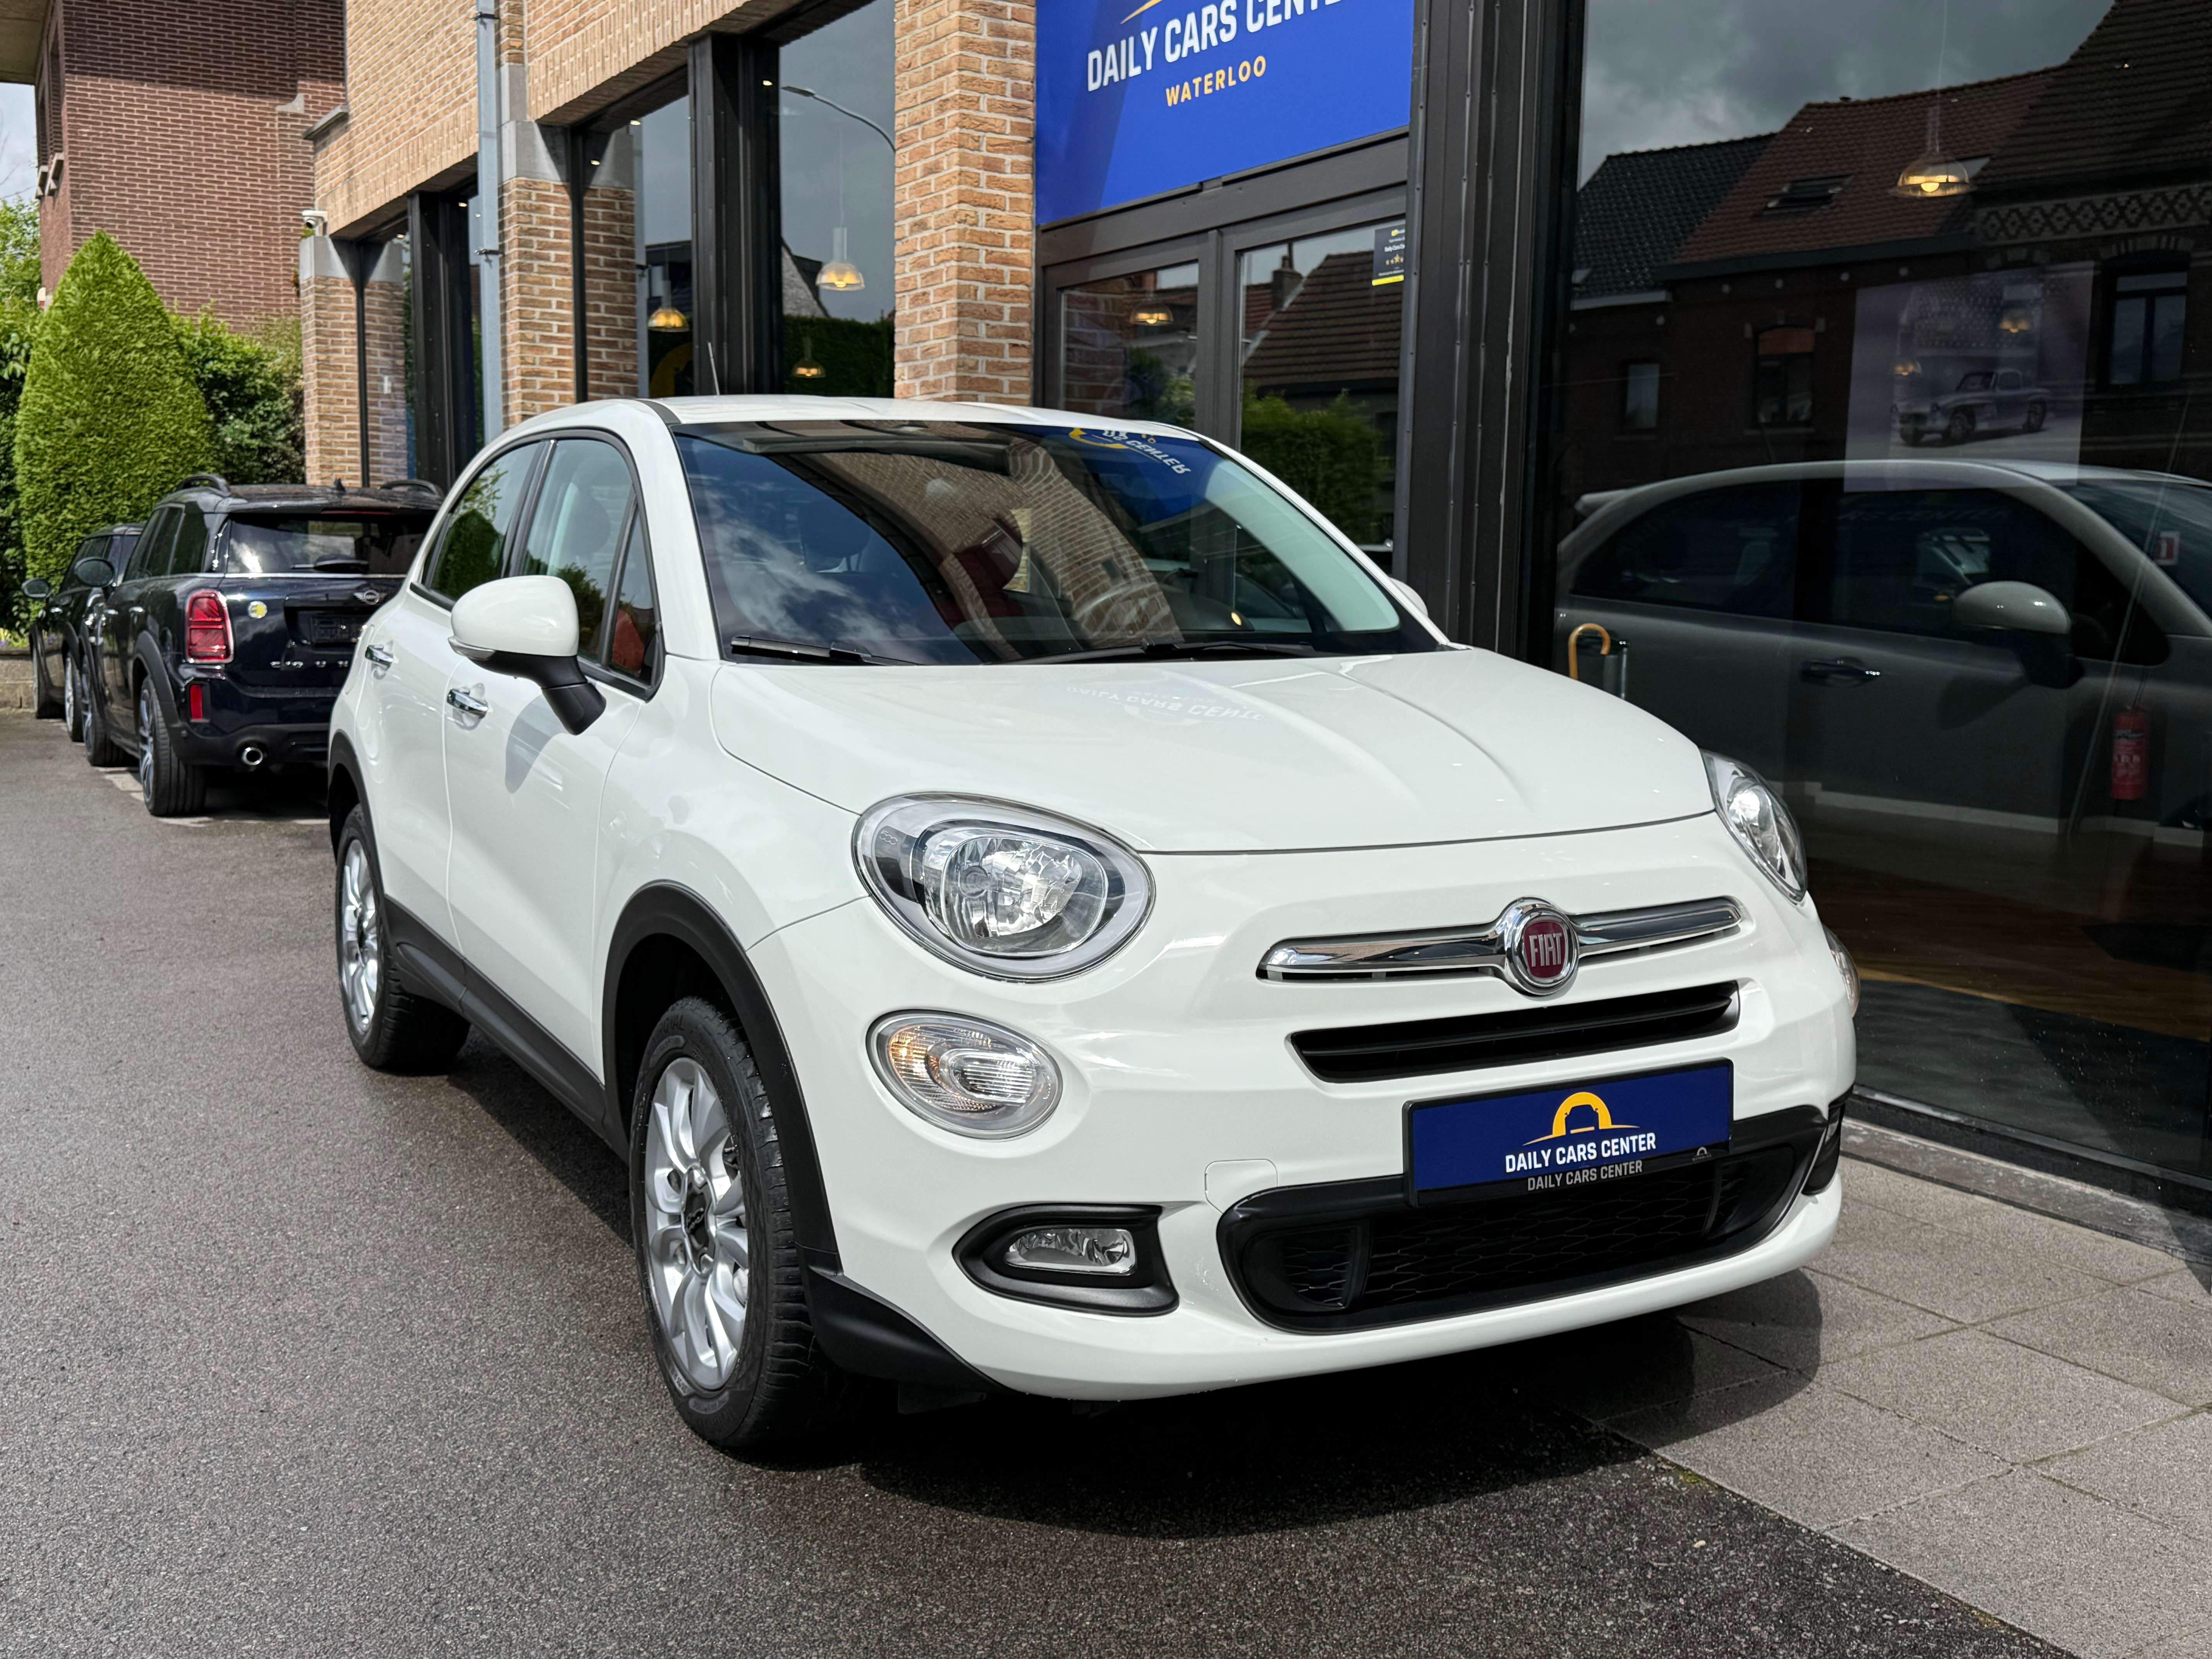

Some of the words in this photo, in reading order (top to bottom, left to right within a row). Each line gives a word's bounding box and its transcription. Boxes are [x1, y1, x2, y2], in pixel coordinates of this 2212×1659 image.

[1087, 26, 1158, 91] DAILY
[1165, 0, 1237, 63] CARS
[1166, 55, 1266, 107] WATERLOO
[1529, 932, 1562, 967] FIAT
[1506, 1149, 1551, 1173] DAILY
[1556, 1142, 1597, 1165] CARS
[1601, 1132, 1656, 1158] CENTER
[1527, 1173, 1563, 1191] DAILY
[1566, 1168, 1597, 1185] CARS
[1601, 1160, 1642, 1179] CENTER
